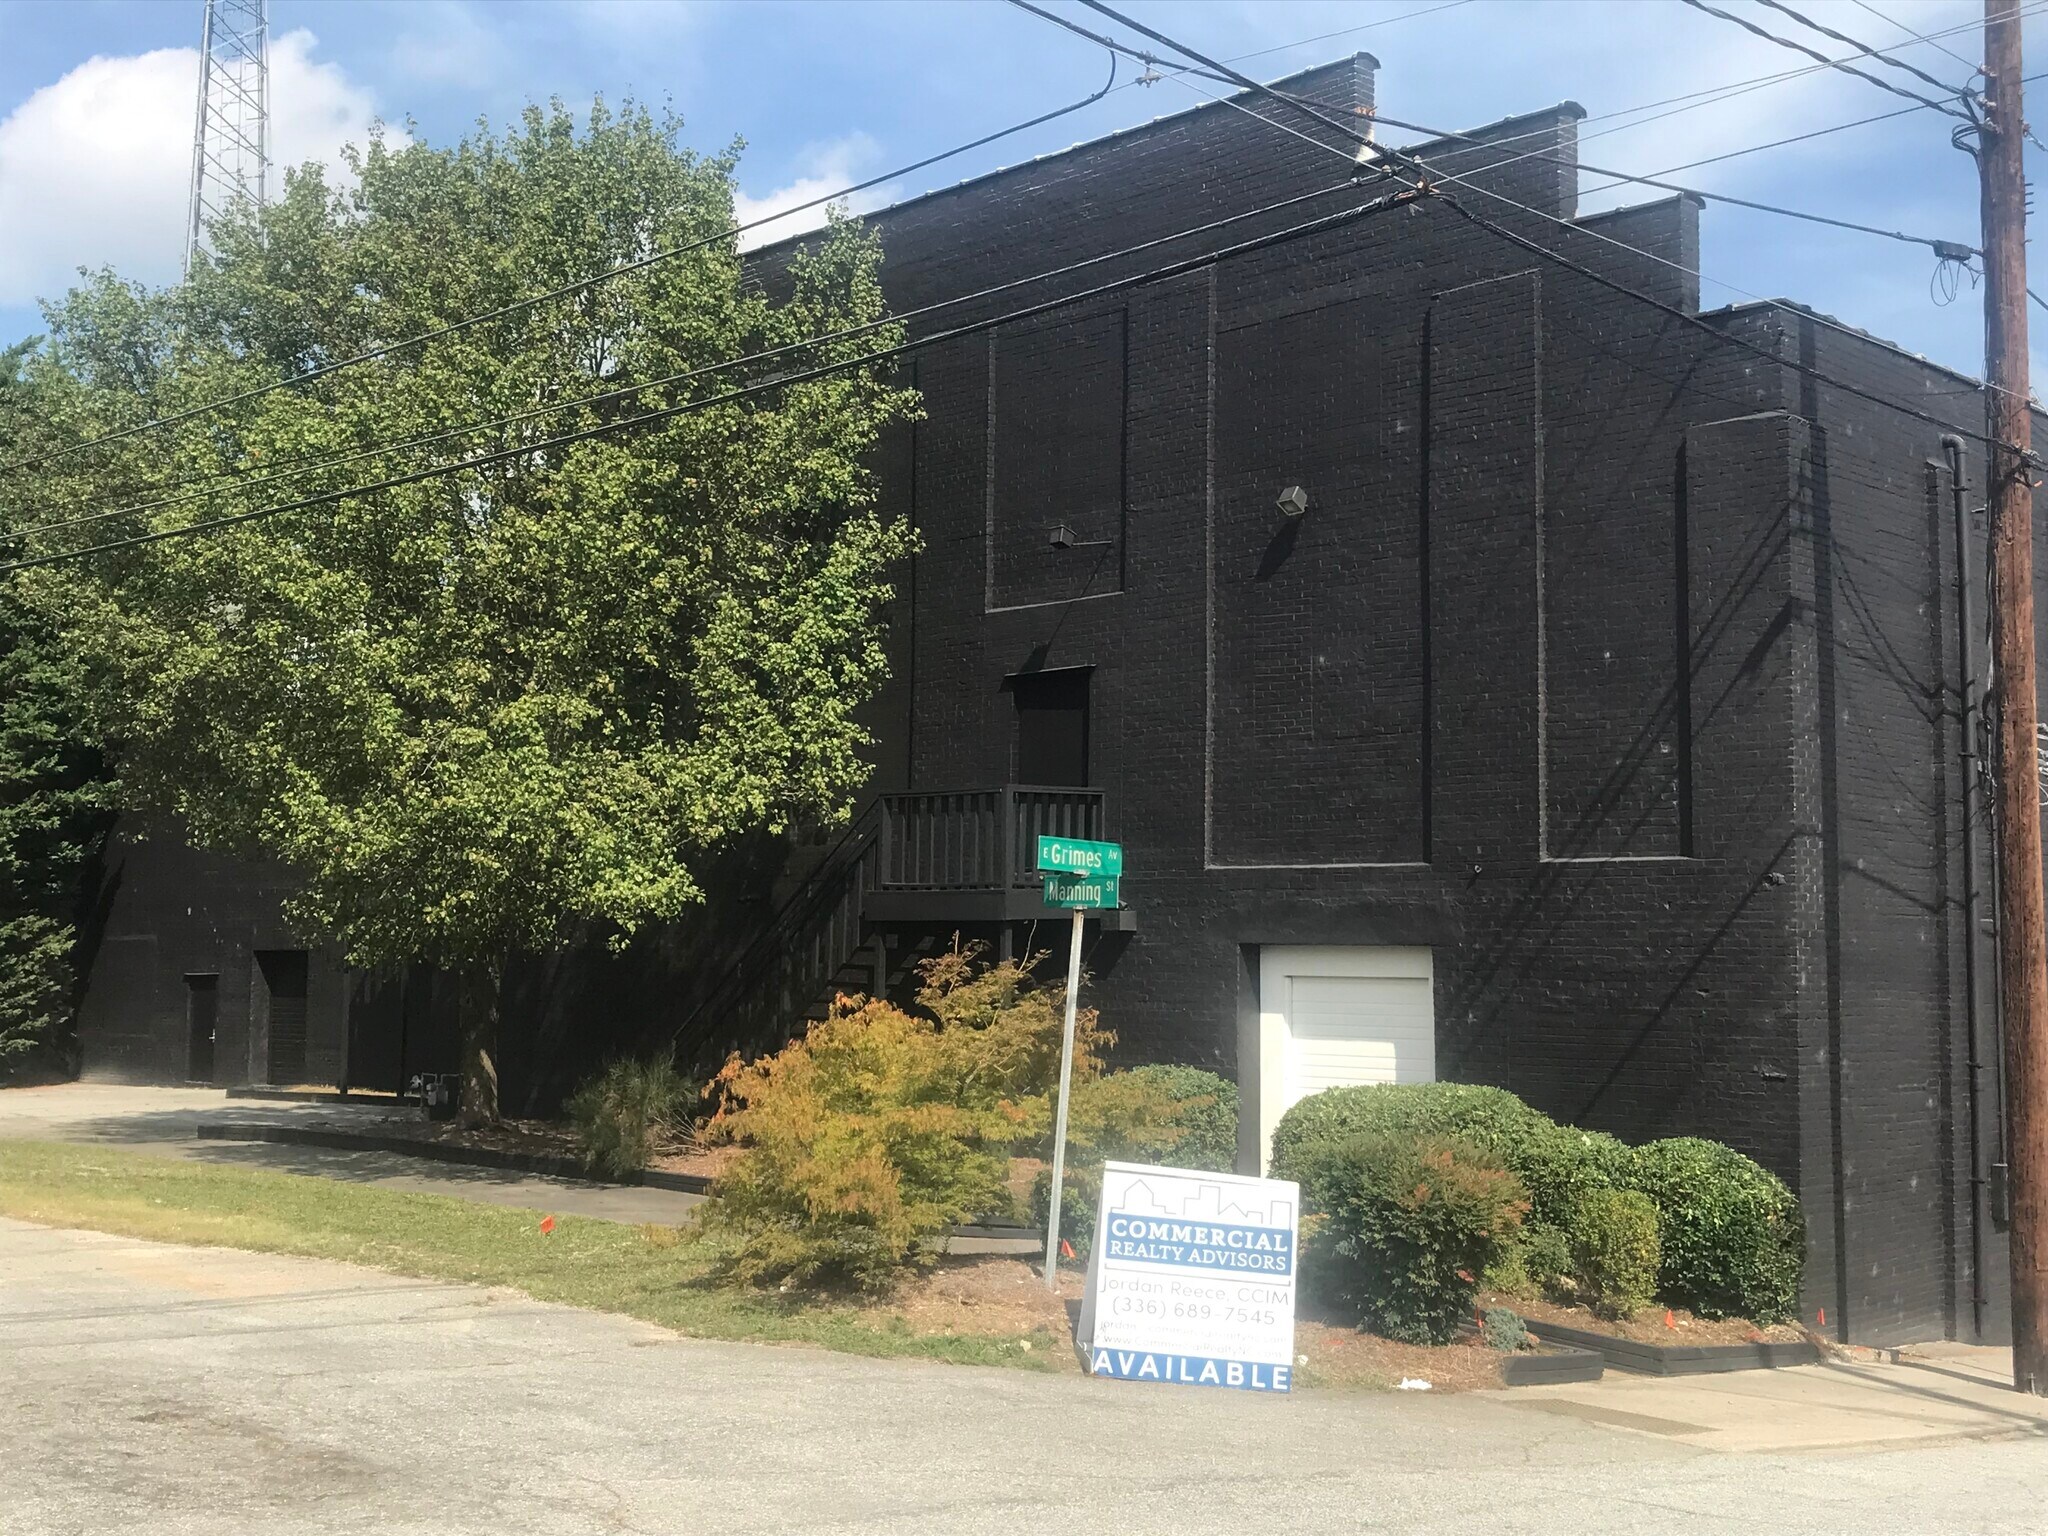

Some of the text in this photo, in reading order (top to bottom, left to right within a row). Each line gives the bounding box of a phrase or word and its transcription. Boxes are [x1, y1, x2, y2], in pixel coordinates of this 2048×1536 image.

[1043, 843, 1118, 868] E Grimes Av
[1048, 880, 1114, 908] Manning St
[1111, 1218, 1288, 1252] COMMERCIAL
[1110, 1240, 1286, 1271] REALTY ADVISORS
[1100, 1274, 1289, 1306] Jordan Reece, CCIM
[1112, 1295, 1276, 1326] (336) 689-7545
[1093, 1350, 1291, 1390] AVAILABLE
